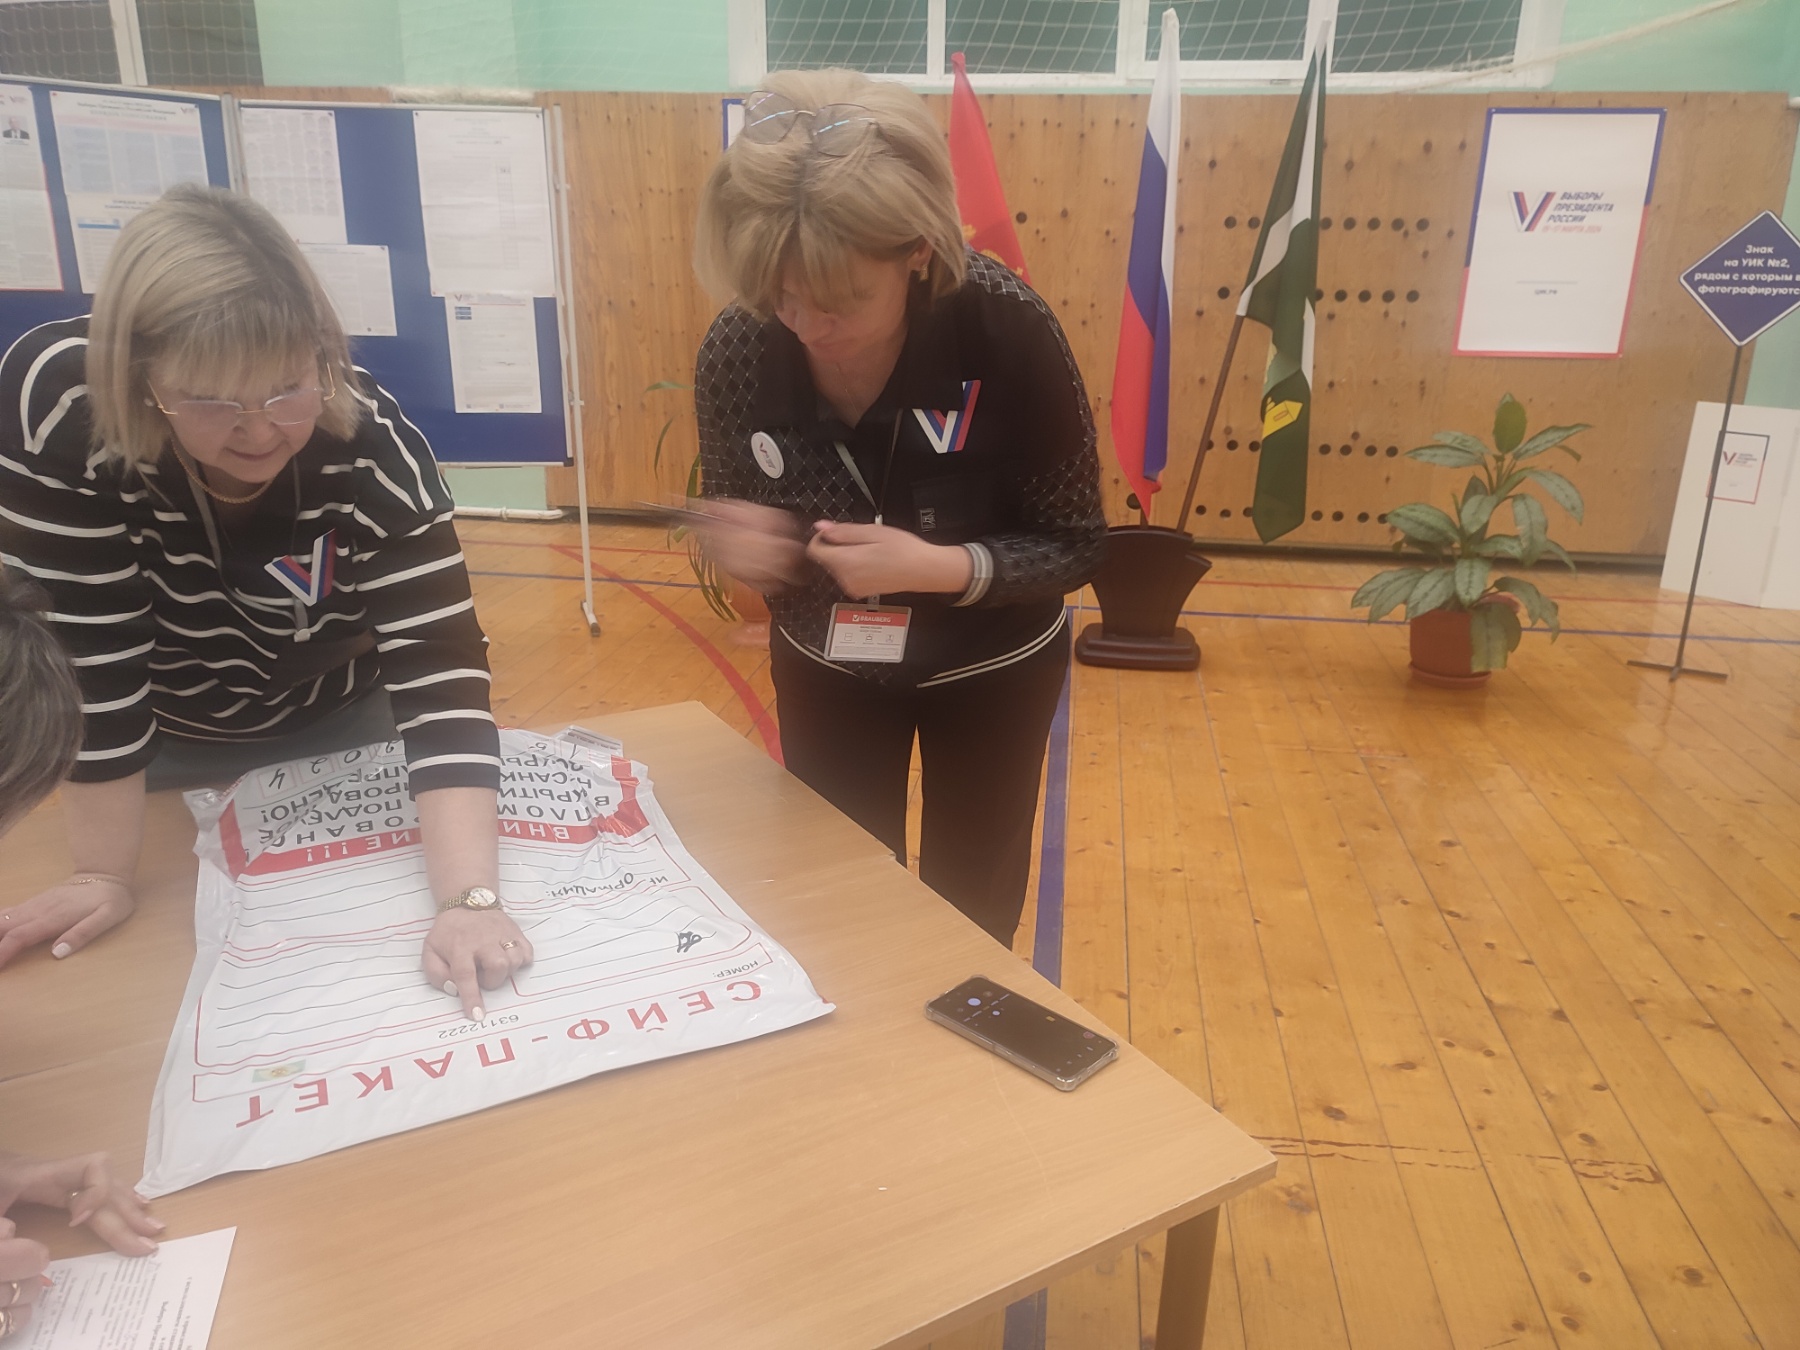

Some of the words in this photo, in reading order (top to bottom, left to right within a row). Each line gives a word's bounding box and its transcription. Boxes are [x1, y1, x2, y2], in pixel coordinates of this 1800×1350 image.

[1560, 191, 1603, 200] ВЫБОРЫ
[1553, 203, 1614, 213] ПРЕЗИДЕНТА
[1547, 214, 1586, 223] РОССИИ
[1745, 244, 1774, 254] Знак
[1724, 259, 1738, 267] на
[1742, 258, 1764, 267] УИК
[1767, 259, 1790, 268] №2,
[1694, 272, 1730, 281] рядом
[1742, 273, 1792, 282] которым
[1698, 284, 1800, 296] фотографируютс
[713, 960, 759, 978] НОМЕР:
